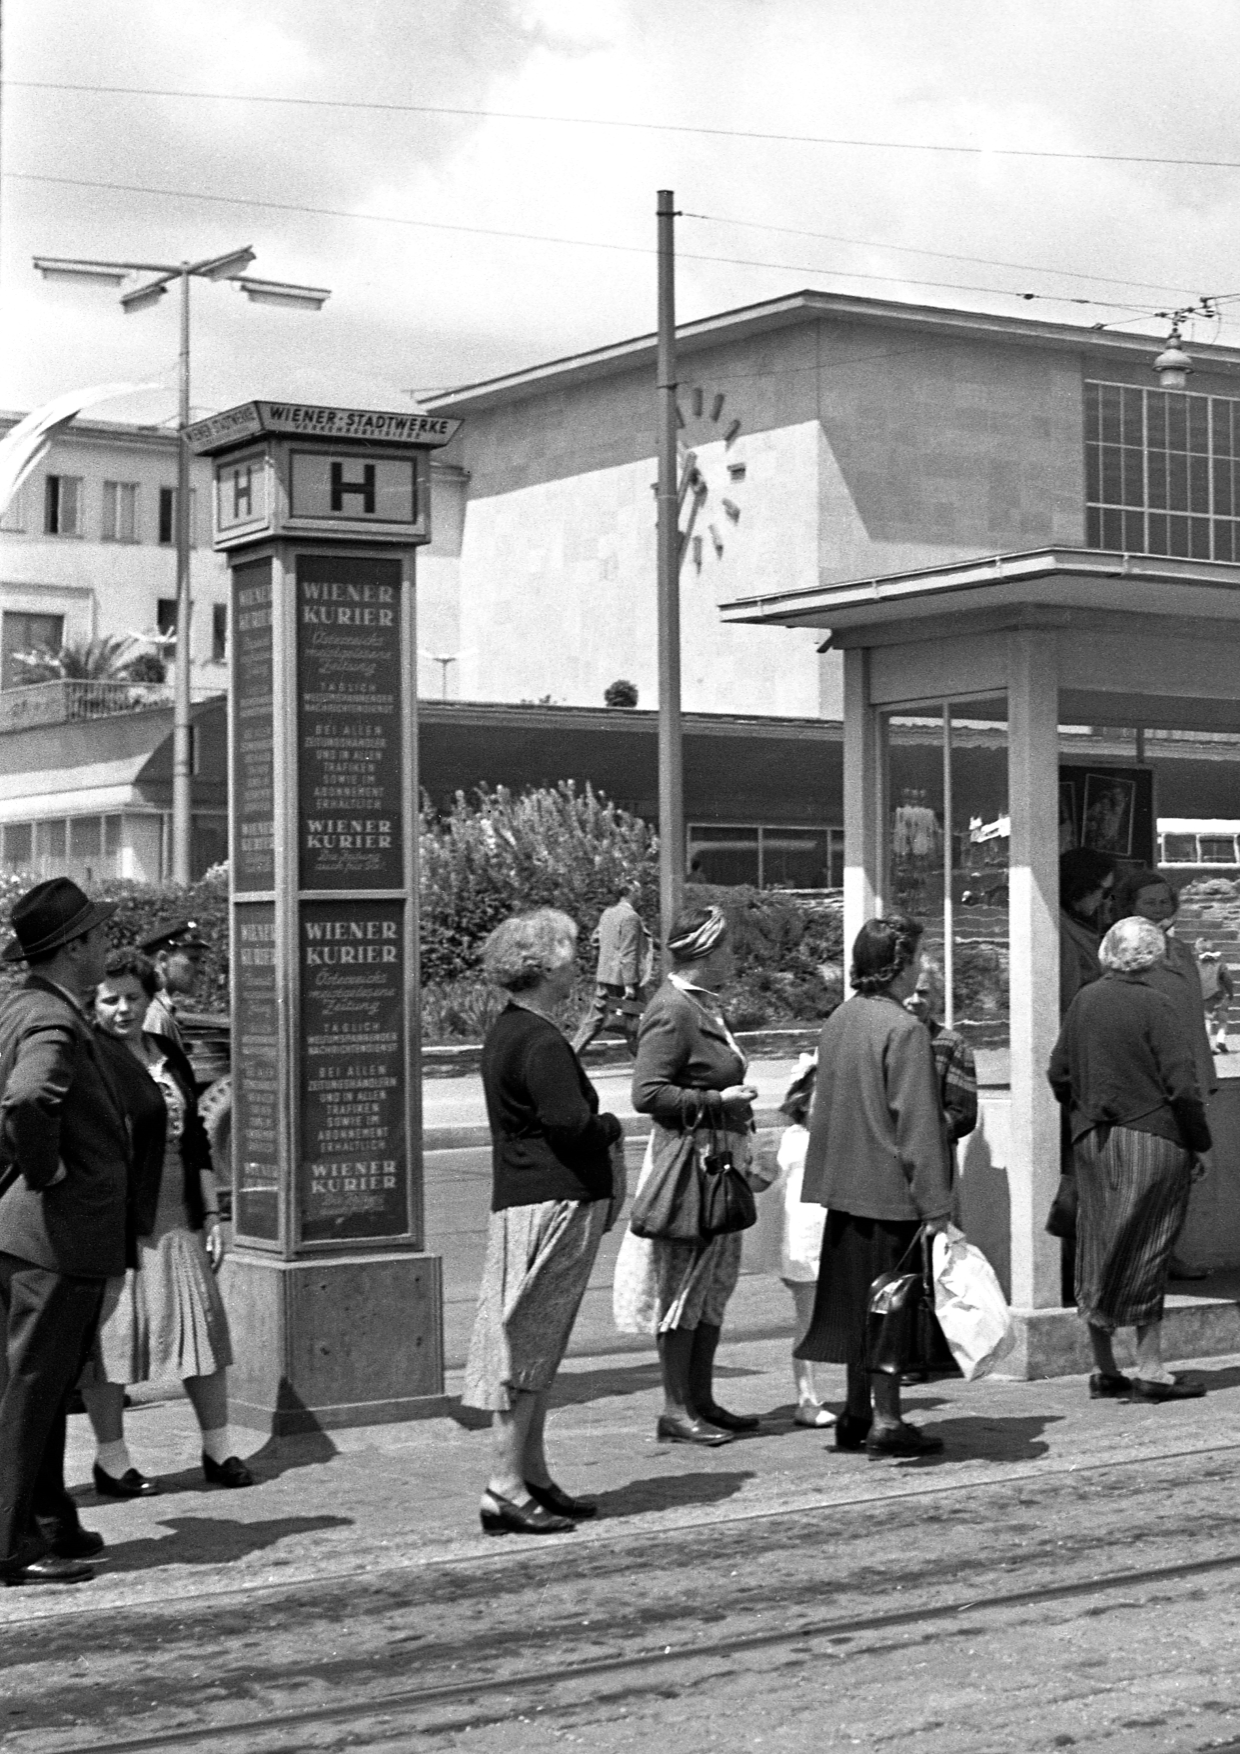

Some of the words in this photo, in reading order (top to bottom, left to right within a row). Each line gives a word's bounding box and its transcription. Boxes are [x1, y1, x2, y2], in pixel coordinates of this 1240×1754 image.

[234, 467, 252, 518] H
[331, 462, 375, 513] H
[302, 582, 393, 603] WIENER
[303, 606, 393, 626] KURIER
[318, 658, 377, 677] Zeitung
[315, 724, 337, 735] BEI
[343, 725, 382, 736] ALLEN
[316, 749, 336, 760] UND
[352, 750, 382, 761] ALLEN
[323, 762, 375, 773] TRAFIKEN
[322, 774, 357, 784] SOWIE
[313, 786, 385, 797] ABONNEMENT
[306, 819, 392, 833] WIENER
[306, 835, 392, 849] KURIER
[304, 921, 398, 940] WIENER
[306, 945, 398, 965] KURIER
[321, 999, 380, 1016] Zeitung
[318, 1066, 341, 1078] BEI
[346, 1065, 386, 1077] ALLEN
[318, 1092, 341, 1103] UND
[342, 1091, 353, 1102] IN
[356, 1090, 387, 1101] ALLEN
[326, 1102, 380, 1115] TRAFIKEN
[326, 1116, 362, 1128] SOWIE
[317, 1126, 389, 1141] ABONNEMENT
[311, 1160, 397, 1178] WIENER
[311, 1175, 397, 1194] KURIER
